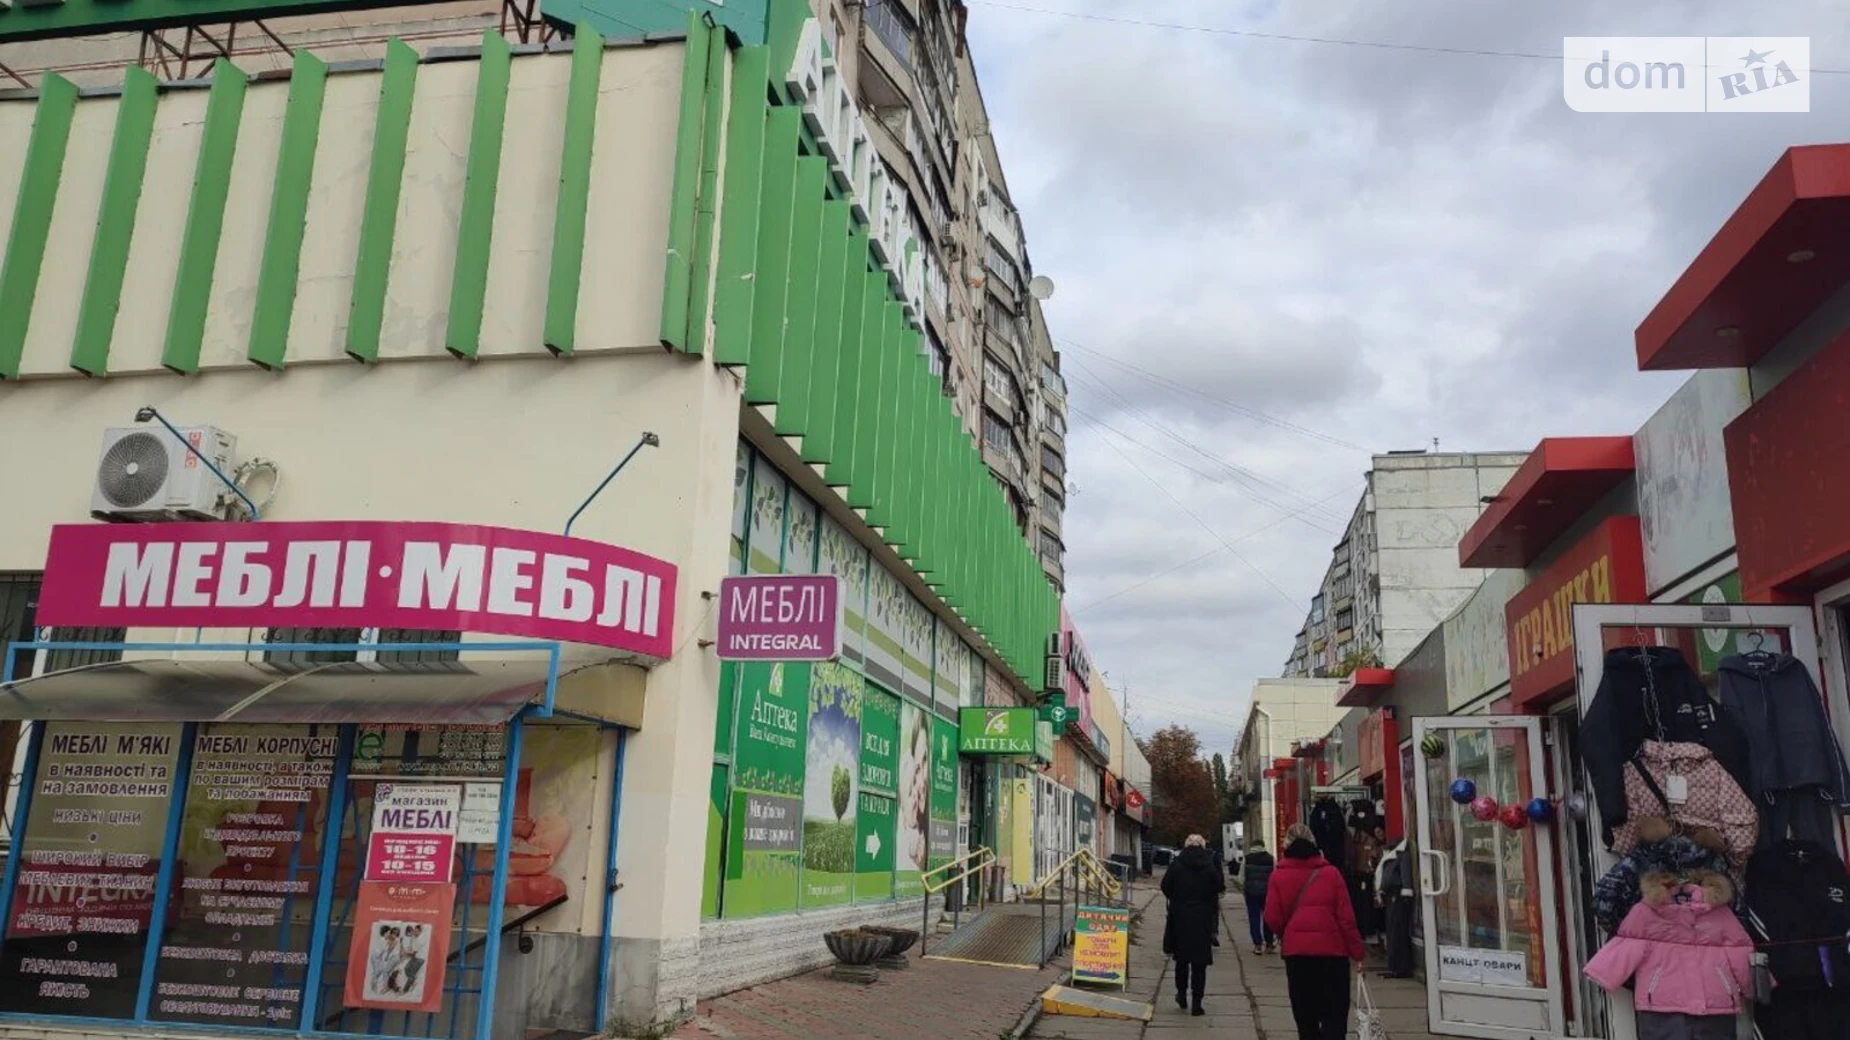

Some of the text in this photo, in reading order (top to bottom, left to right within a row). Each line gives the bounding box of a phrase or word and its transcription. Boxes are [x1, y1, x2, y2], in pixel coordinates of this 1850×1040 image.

[100, 539, 660, 638] МЕБЛІ МЕБЛІ
[729, 577, 826, 626] МЕБЛІ
[729, 633, 823, 651] INTEGRAL
[751, 689, 798, 733] Аптека
[51, 734, 172, 756] МЕБЛІ М'ЯКІ
[198, 736, 339, 757] МЕБЛІ КОРПУСНІ
[962, 738, 1031, 752] АПТЕКА
[49, 762, 168, 779] в наявності та
[291, 762, 333, 775] також
[42, 781, 168, 797] на замовлення
[213, 774, 261, 787] вашим
[207, 788, 221, 800] та
[391, 797, 449, 807] магазин
[53, 809, 143, 826] НИЗЬКІ ЦІНИ
[380, 808, 453, 830] МЕБЛІ
